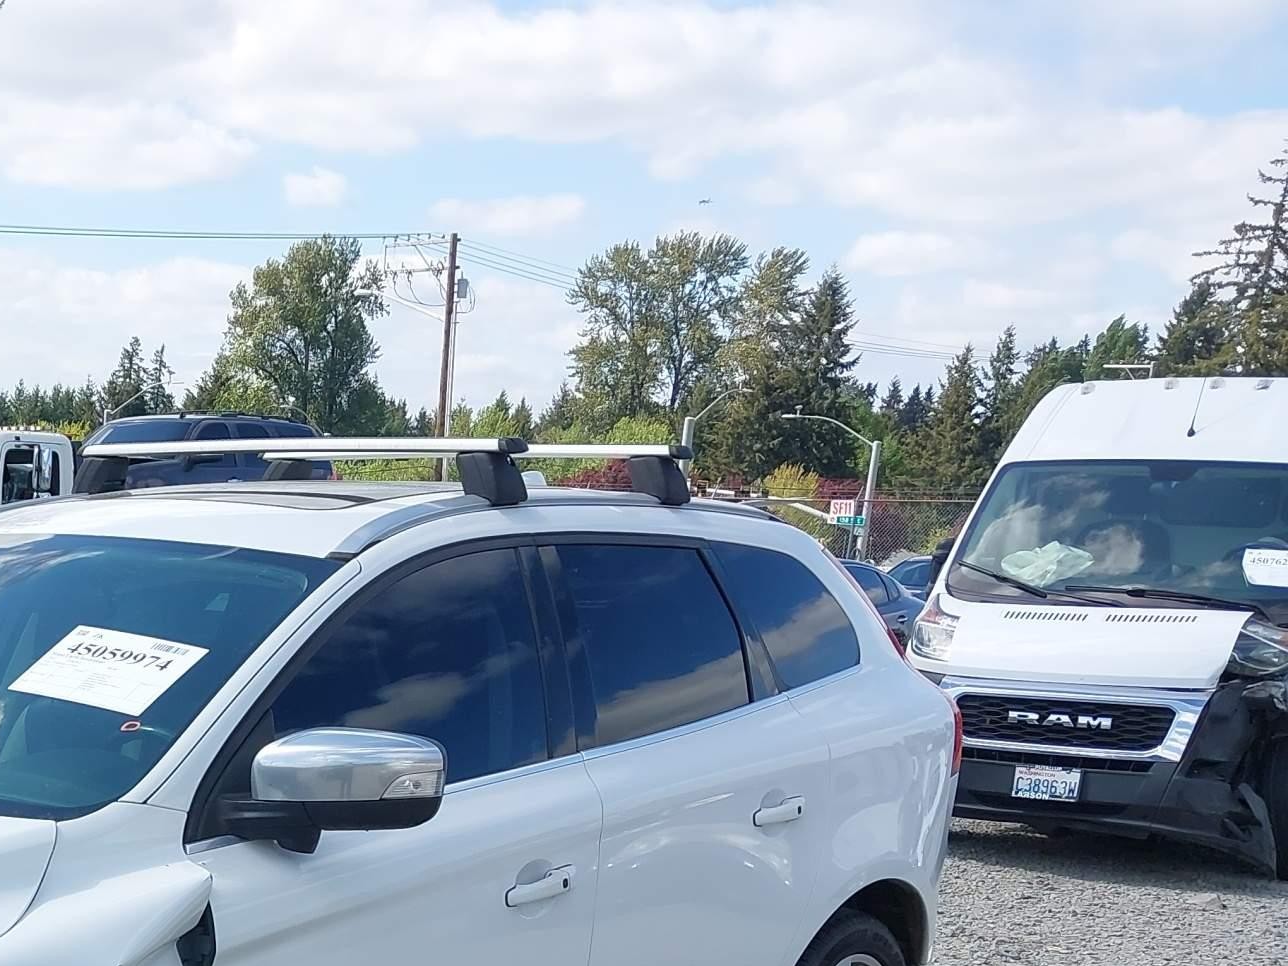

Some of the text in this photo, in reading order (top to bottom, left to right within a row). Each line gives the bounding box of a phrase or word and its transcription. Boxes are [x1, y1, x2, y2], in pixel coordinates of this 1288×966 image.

[67, 641, 174, 671] 45059974
[1006, 709, 1112, 729] RAM
[1016, 777, 1077, 798] C38963W
